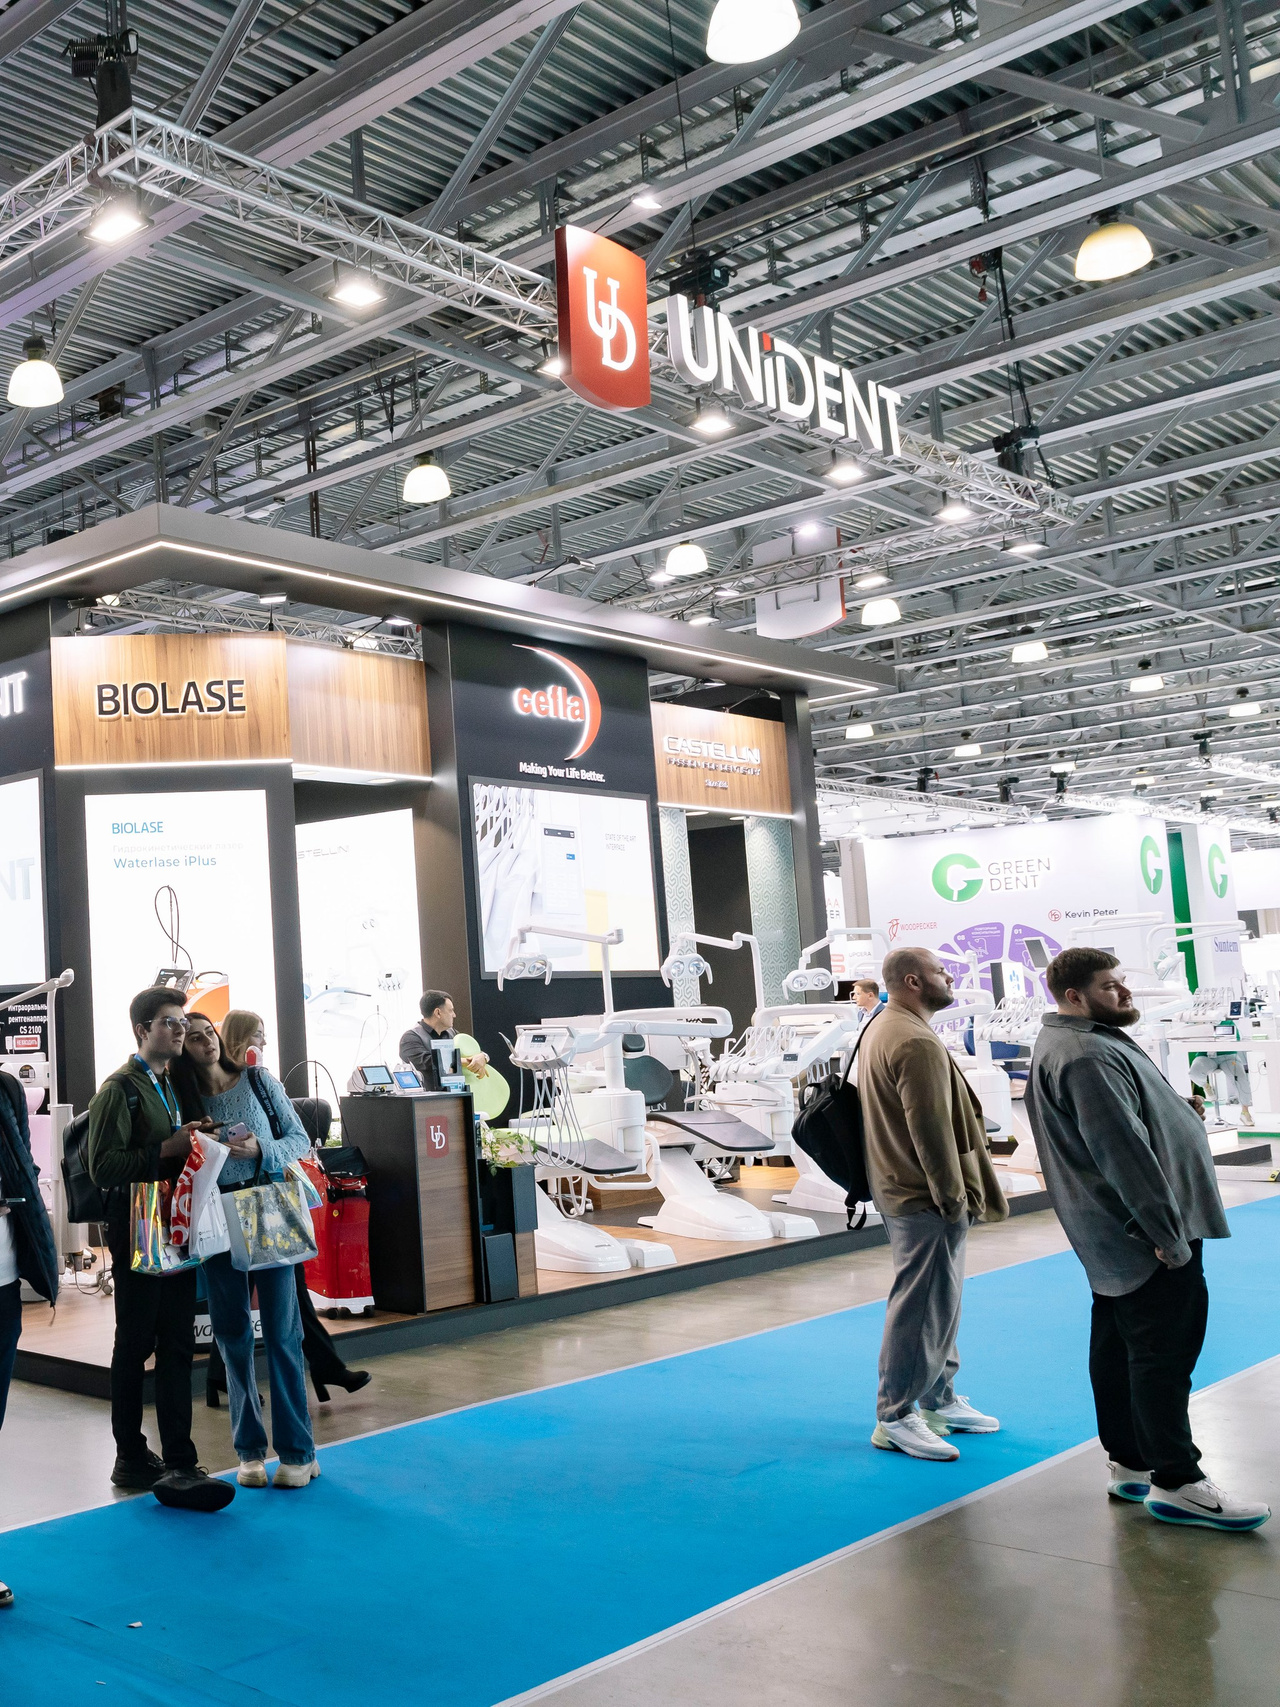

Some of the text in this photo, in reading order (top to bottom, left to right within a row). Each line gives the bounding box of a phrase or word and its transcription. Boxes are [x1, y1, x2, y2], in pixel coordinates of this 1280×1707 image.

[96, 678, 246, 717] BIOLASE
[516, 685, 585, 721] cefla
[519, 762, 548, 778] Making
[548, 765, 566, 777] Your
[566, 767, 580, 779] Life
[111, 821, 164, 834] BIOLASE
[112, 842, 244, 854] Гидрокинетический лазер
[114, 855, 217, 869] Waterlase iPlus
[988, 857, 1051, 876] GREEN
[990, 874, 1039, 892] DENT
[1065, 909, 1091, 919] Kevin
[1093, 908, 1119, 917] Peter
[900, 922, 937, 931] WOODPECKER
[1214, 937, 1239, 953] Suntem
[28, 1026, 42, 1034] 2100
